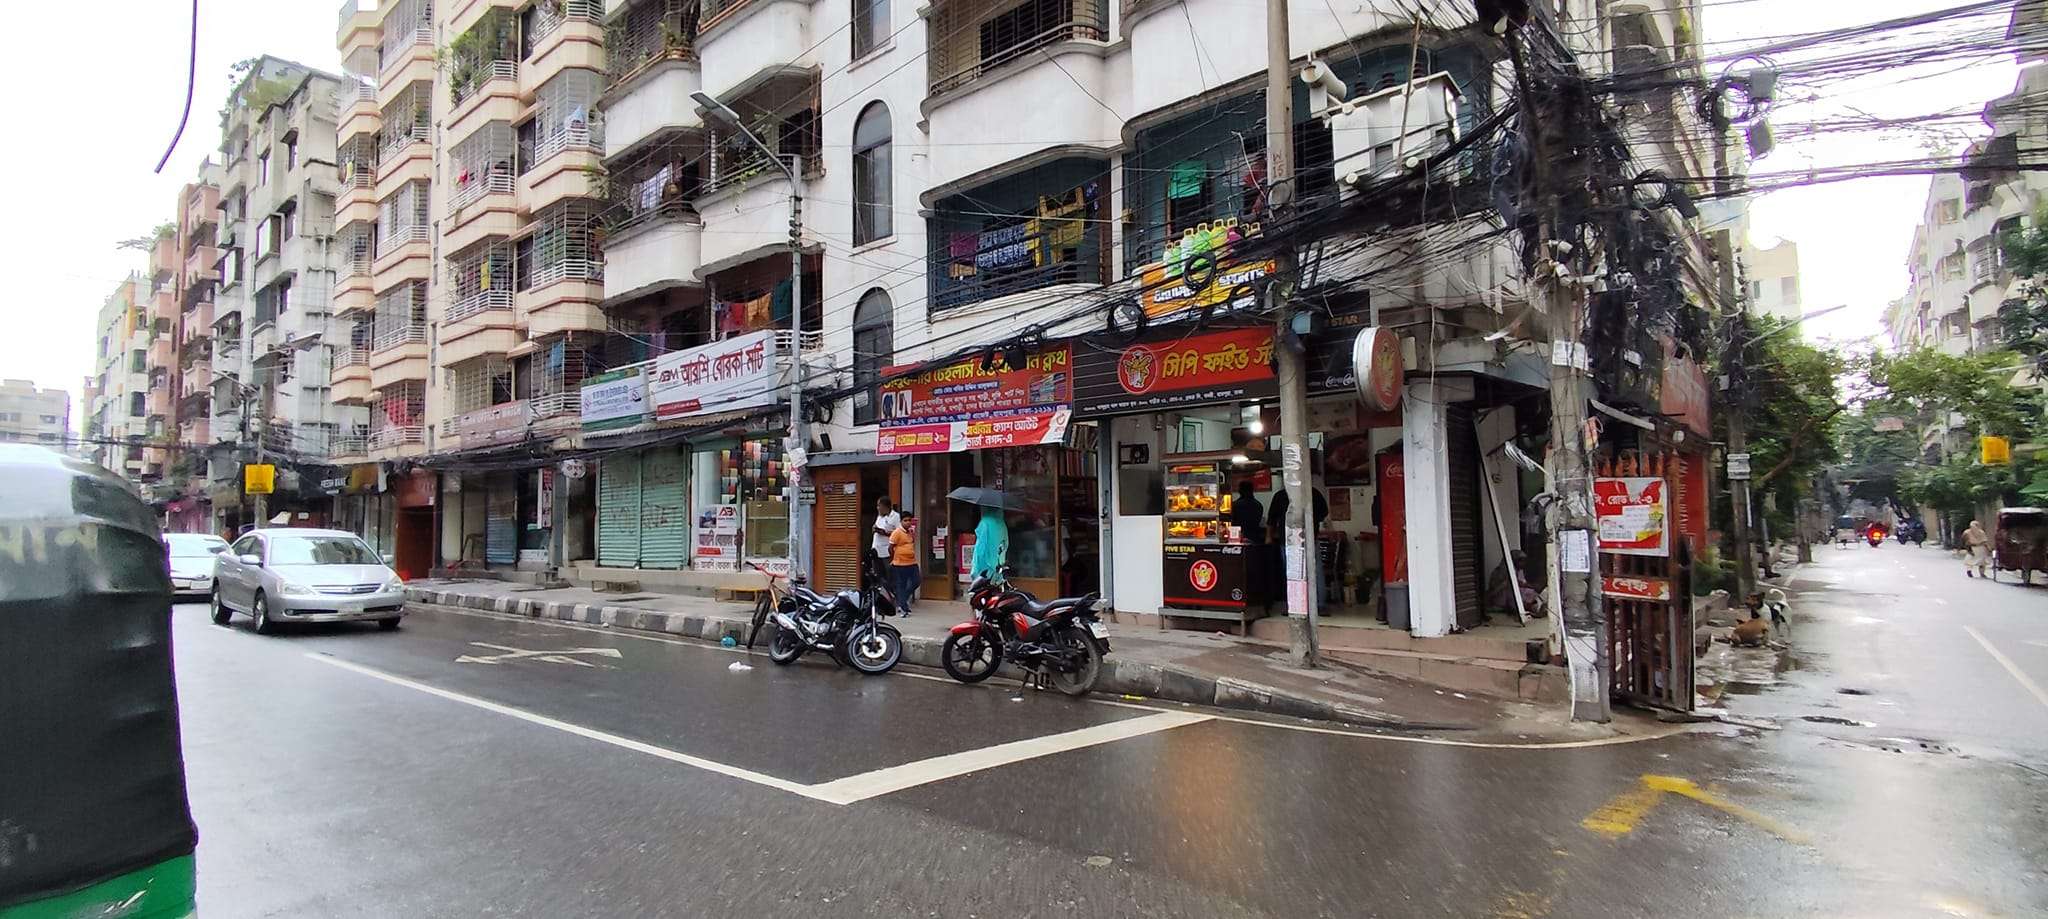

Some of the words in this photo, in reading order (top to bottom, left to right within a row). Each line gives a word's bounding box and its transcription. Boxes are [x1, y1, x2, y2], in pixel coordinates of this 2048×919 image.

[680, 353, 710, 387] আরশি
[713, 349, 744, 382] বোরকা
[746, 339, 766, 375] মার্ট
[1042, 350, 1068, 372] ক্লথ
[1162, 352, 1199, 378] সিপি
[1203, 344, 1250, 373] ফাইভ
[993, 422, 1014, 432] ক্যাশ
[1014, 416, 1039, 431] আউট
